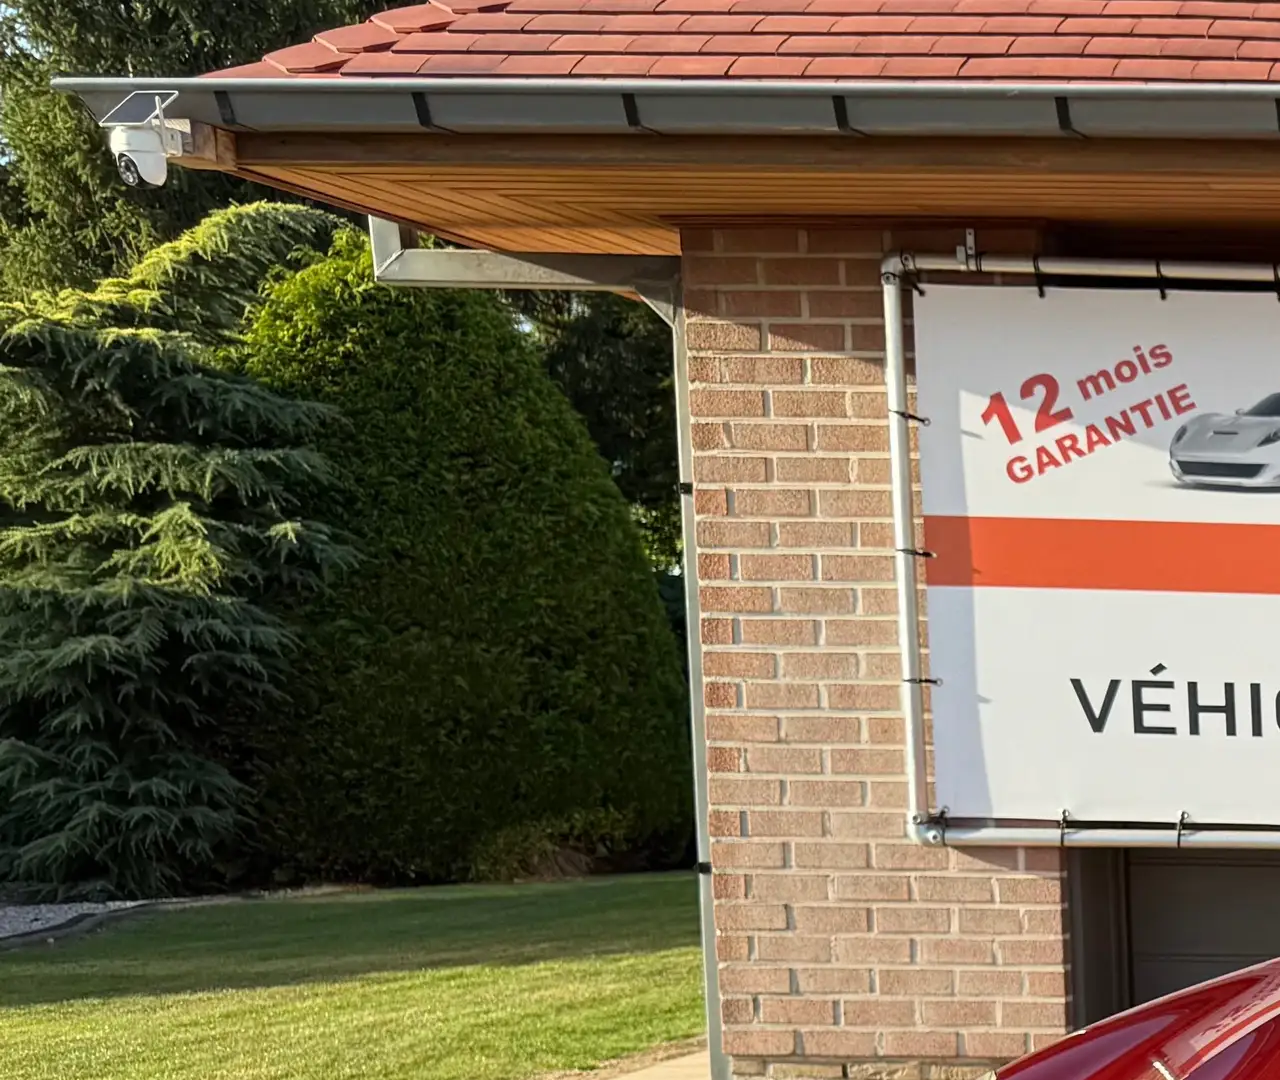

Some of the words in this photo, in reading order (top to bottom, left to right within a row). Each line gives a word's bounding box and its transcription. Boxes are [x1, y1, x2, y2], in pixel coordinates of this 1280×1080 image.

[980, 372, 1072, 446] 12
[1077, 342, 1174, 402] mois
[1006, 382, 1198, 485] GARANTIE
